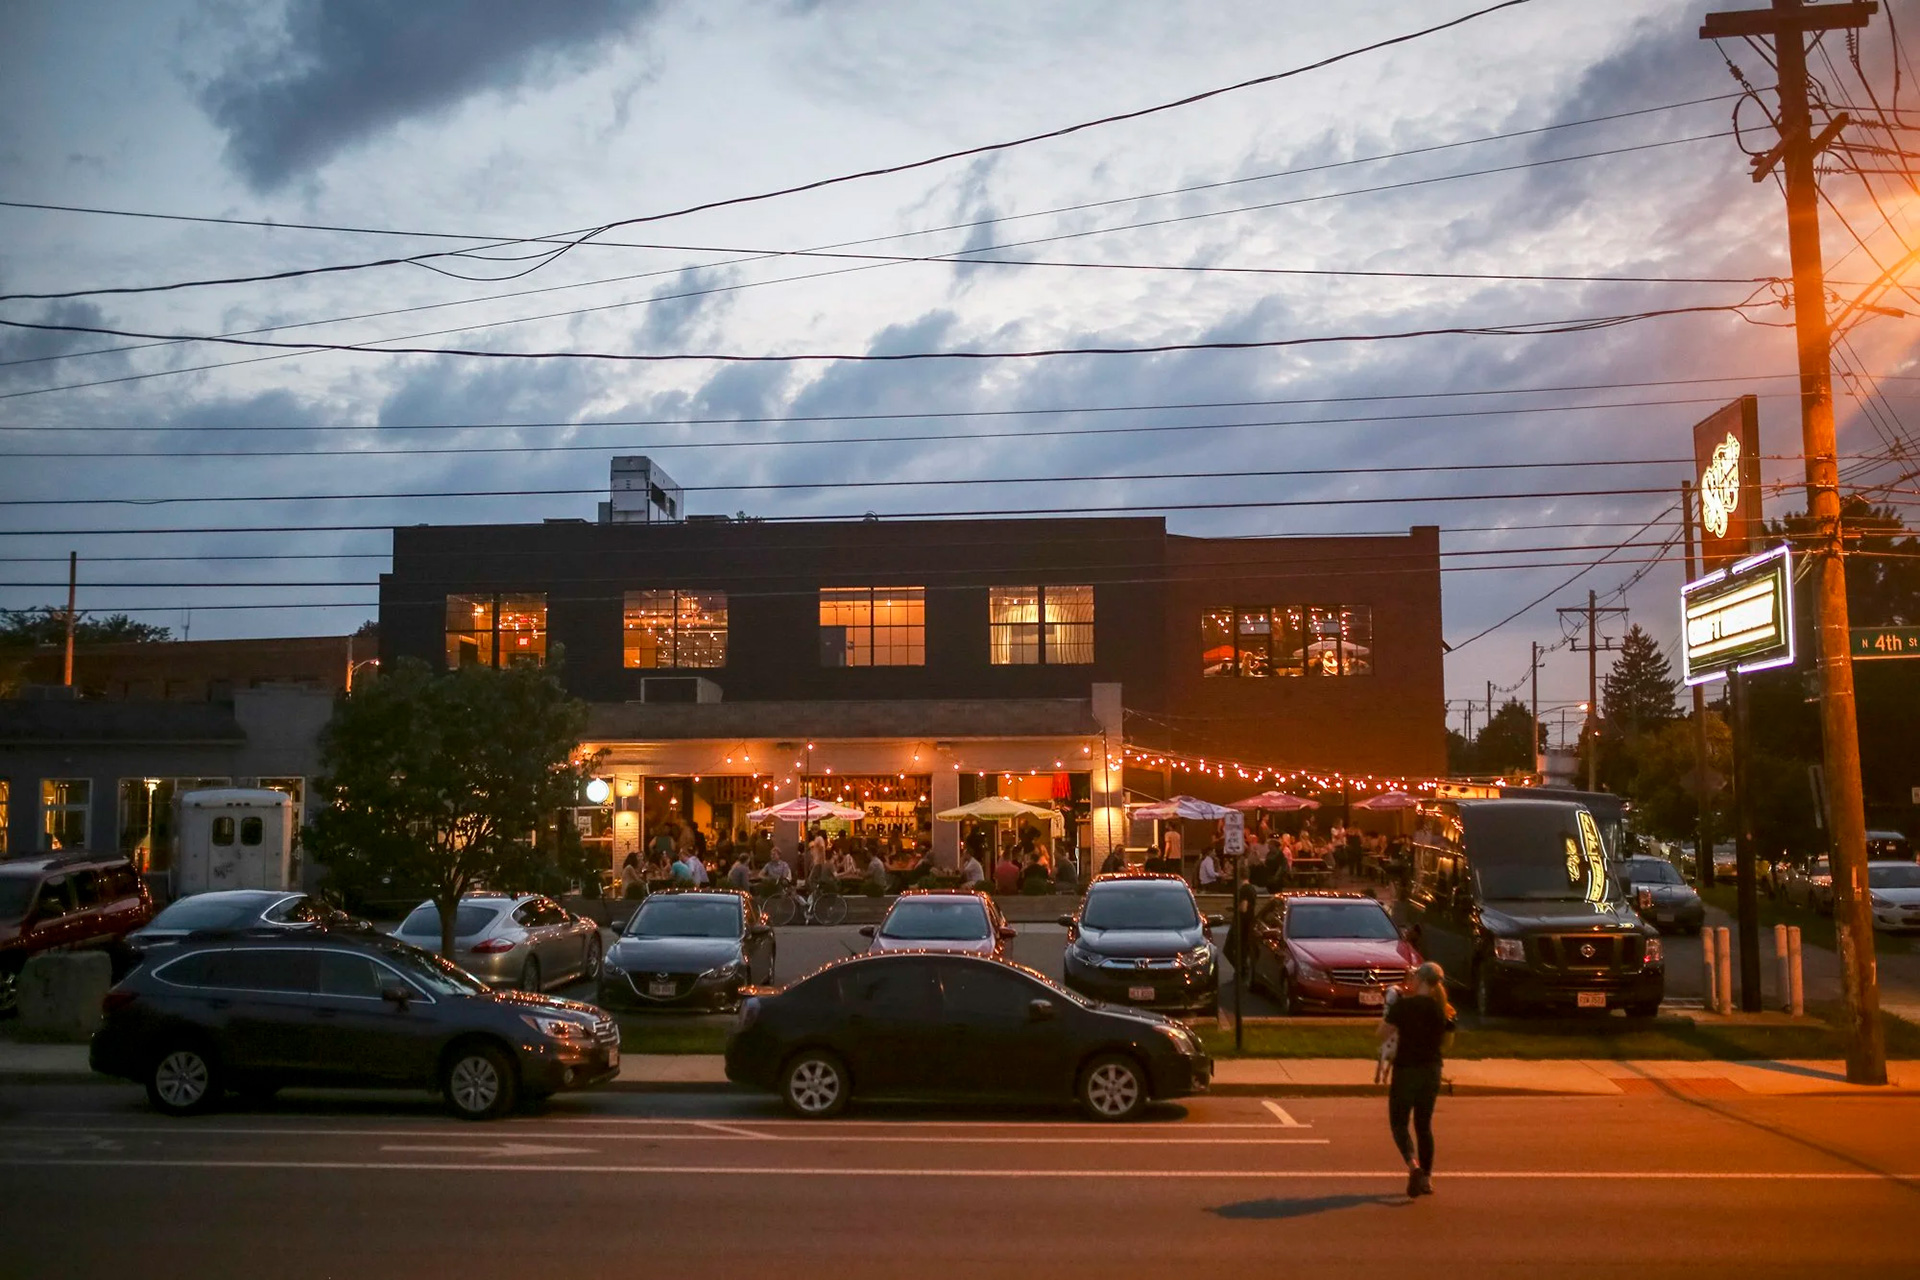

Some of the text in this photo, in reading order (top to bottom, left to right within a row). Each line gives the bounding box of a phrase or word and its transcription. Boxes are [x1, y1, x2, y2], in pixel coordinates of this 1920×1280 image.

[1862, 634, 1918, 651] N 4th St
[866, 822, 914, 835] DRINK
